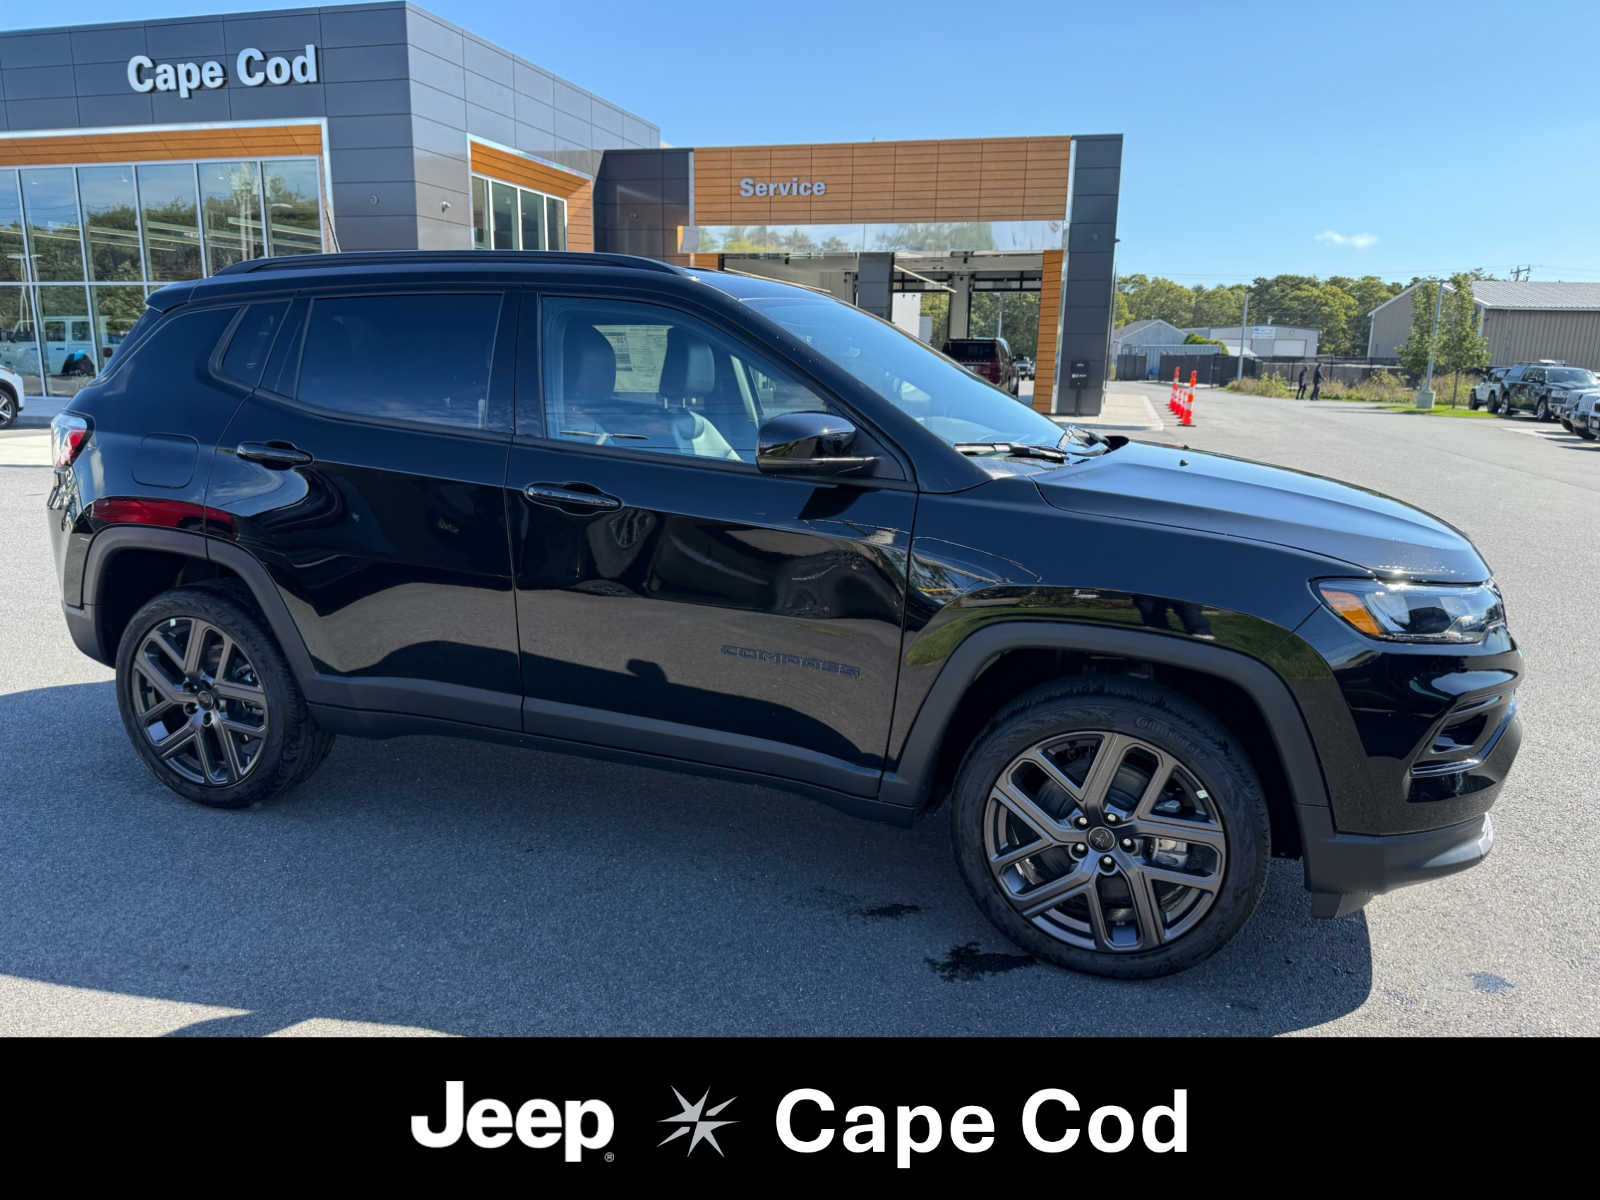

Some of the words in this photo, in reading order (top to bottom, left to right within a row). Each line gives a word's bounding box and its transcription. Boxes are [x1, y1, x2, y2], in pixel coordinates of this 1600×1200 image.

[127, 55, 225, 98] Cape
[236, 44, 318, 87] Cod
[740, 177, 826, 197] Service
[720, 644, 862, 680] COMPASS
